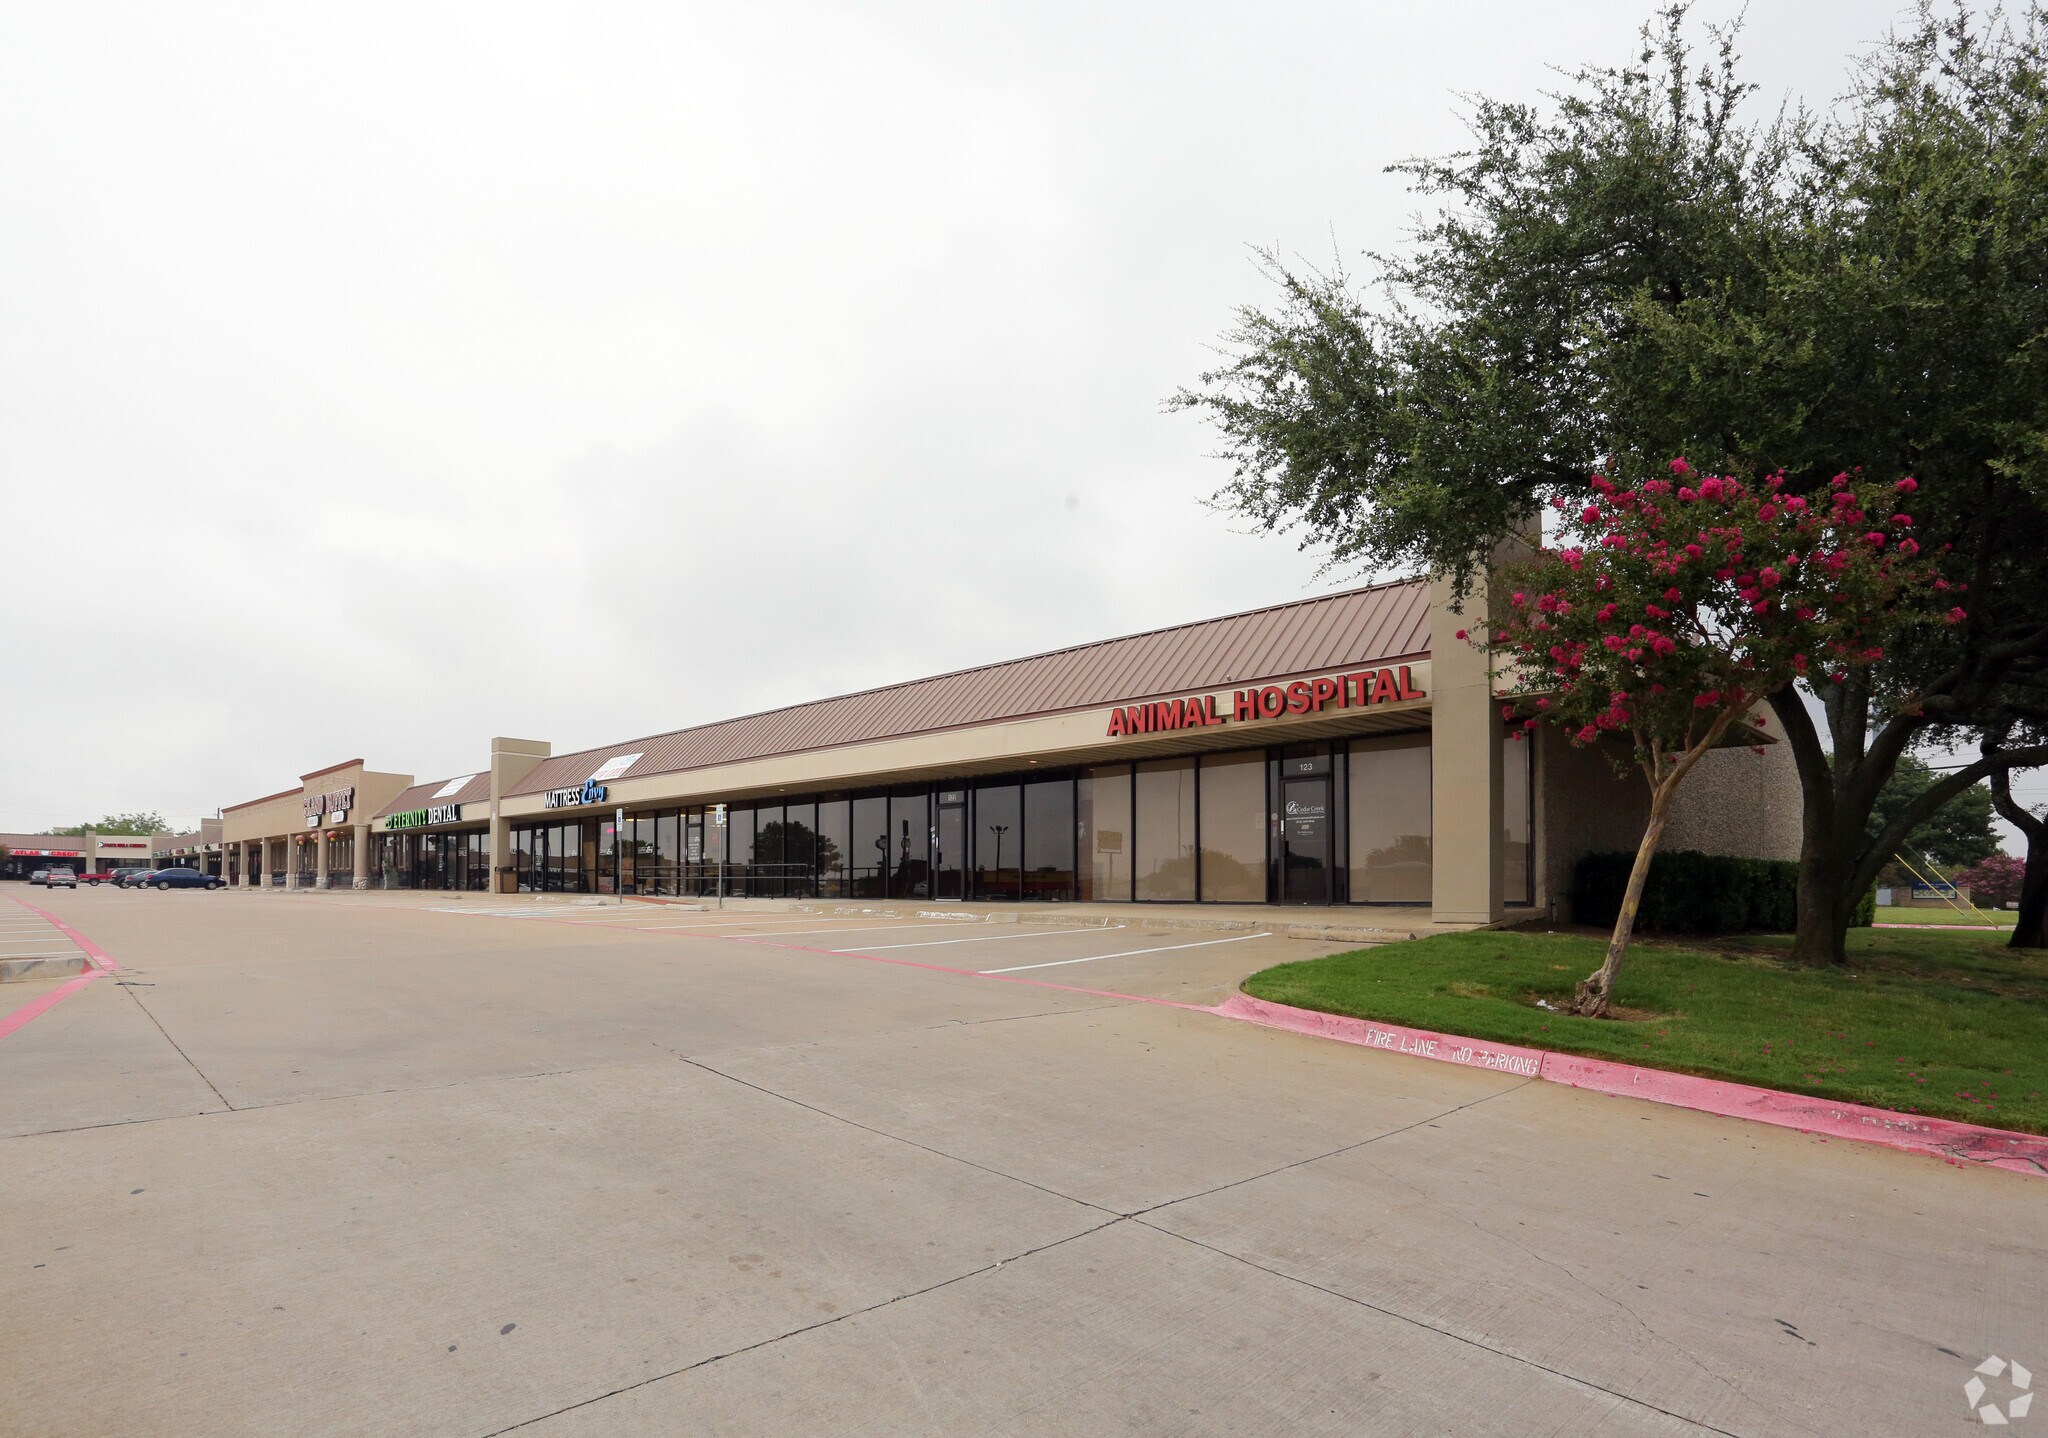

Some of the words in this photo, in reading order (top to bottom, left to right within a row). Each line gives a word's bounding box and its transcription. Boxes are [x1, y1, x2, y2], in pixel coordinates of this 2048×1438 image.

[1106, 695, 1226, 736] ANIMAL
[1233, 665, 1427, 722] HOSPITAL
[1299, 763, 1313, 771] 123
[303, 794, 324, 818] GRAND
[326, 786, 352, 813] BUFFET
[544, 787, 580, 809] MATTRESS
[581, 779, 604, 805] Envy
[393, 808, 427, 829] ETERNITY
[428, 803, 457, 825] DENTAL
[1365, 1029, 1397, 1049] FIRE
[1400, 1035, 1439, 1057] LANE
[1451, 1045, 1473, 1062] NO
[1477, 1049, 1539, 1075] PARKING
